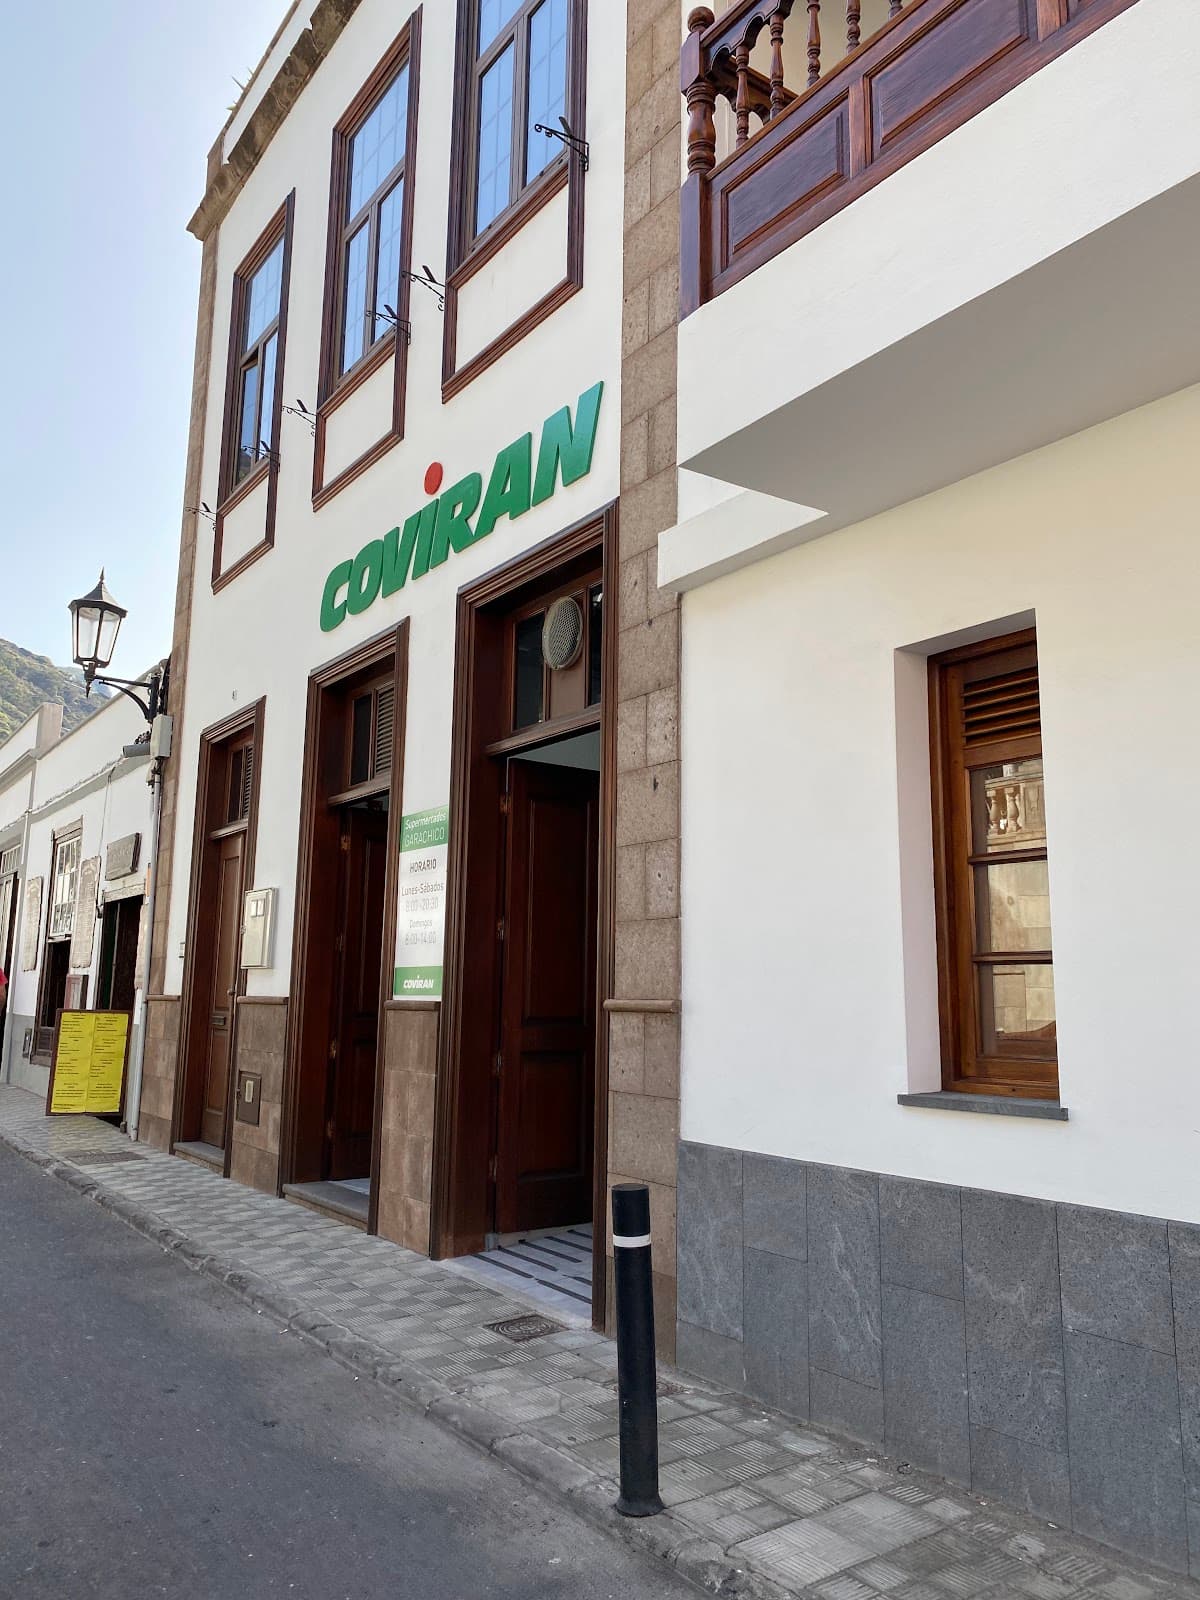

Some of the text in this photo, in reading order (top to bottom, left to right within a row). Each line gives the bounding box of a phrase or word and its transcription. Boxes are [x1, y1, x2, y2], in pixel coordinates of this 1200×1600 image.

[319, 380, 604, 632] COVIRAN
[404, 826, 445, 848] GARACHICO
[409, 858, 437, 873] HORARIO
